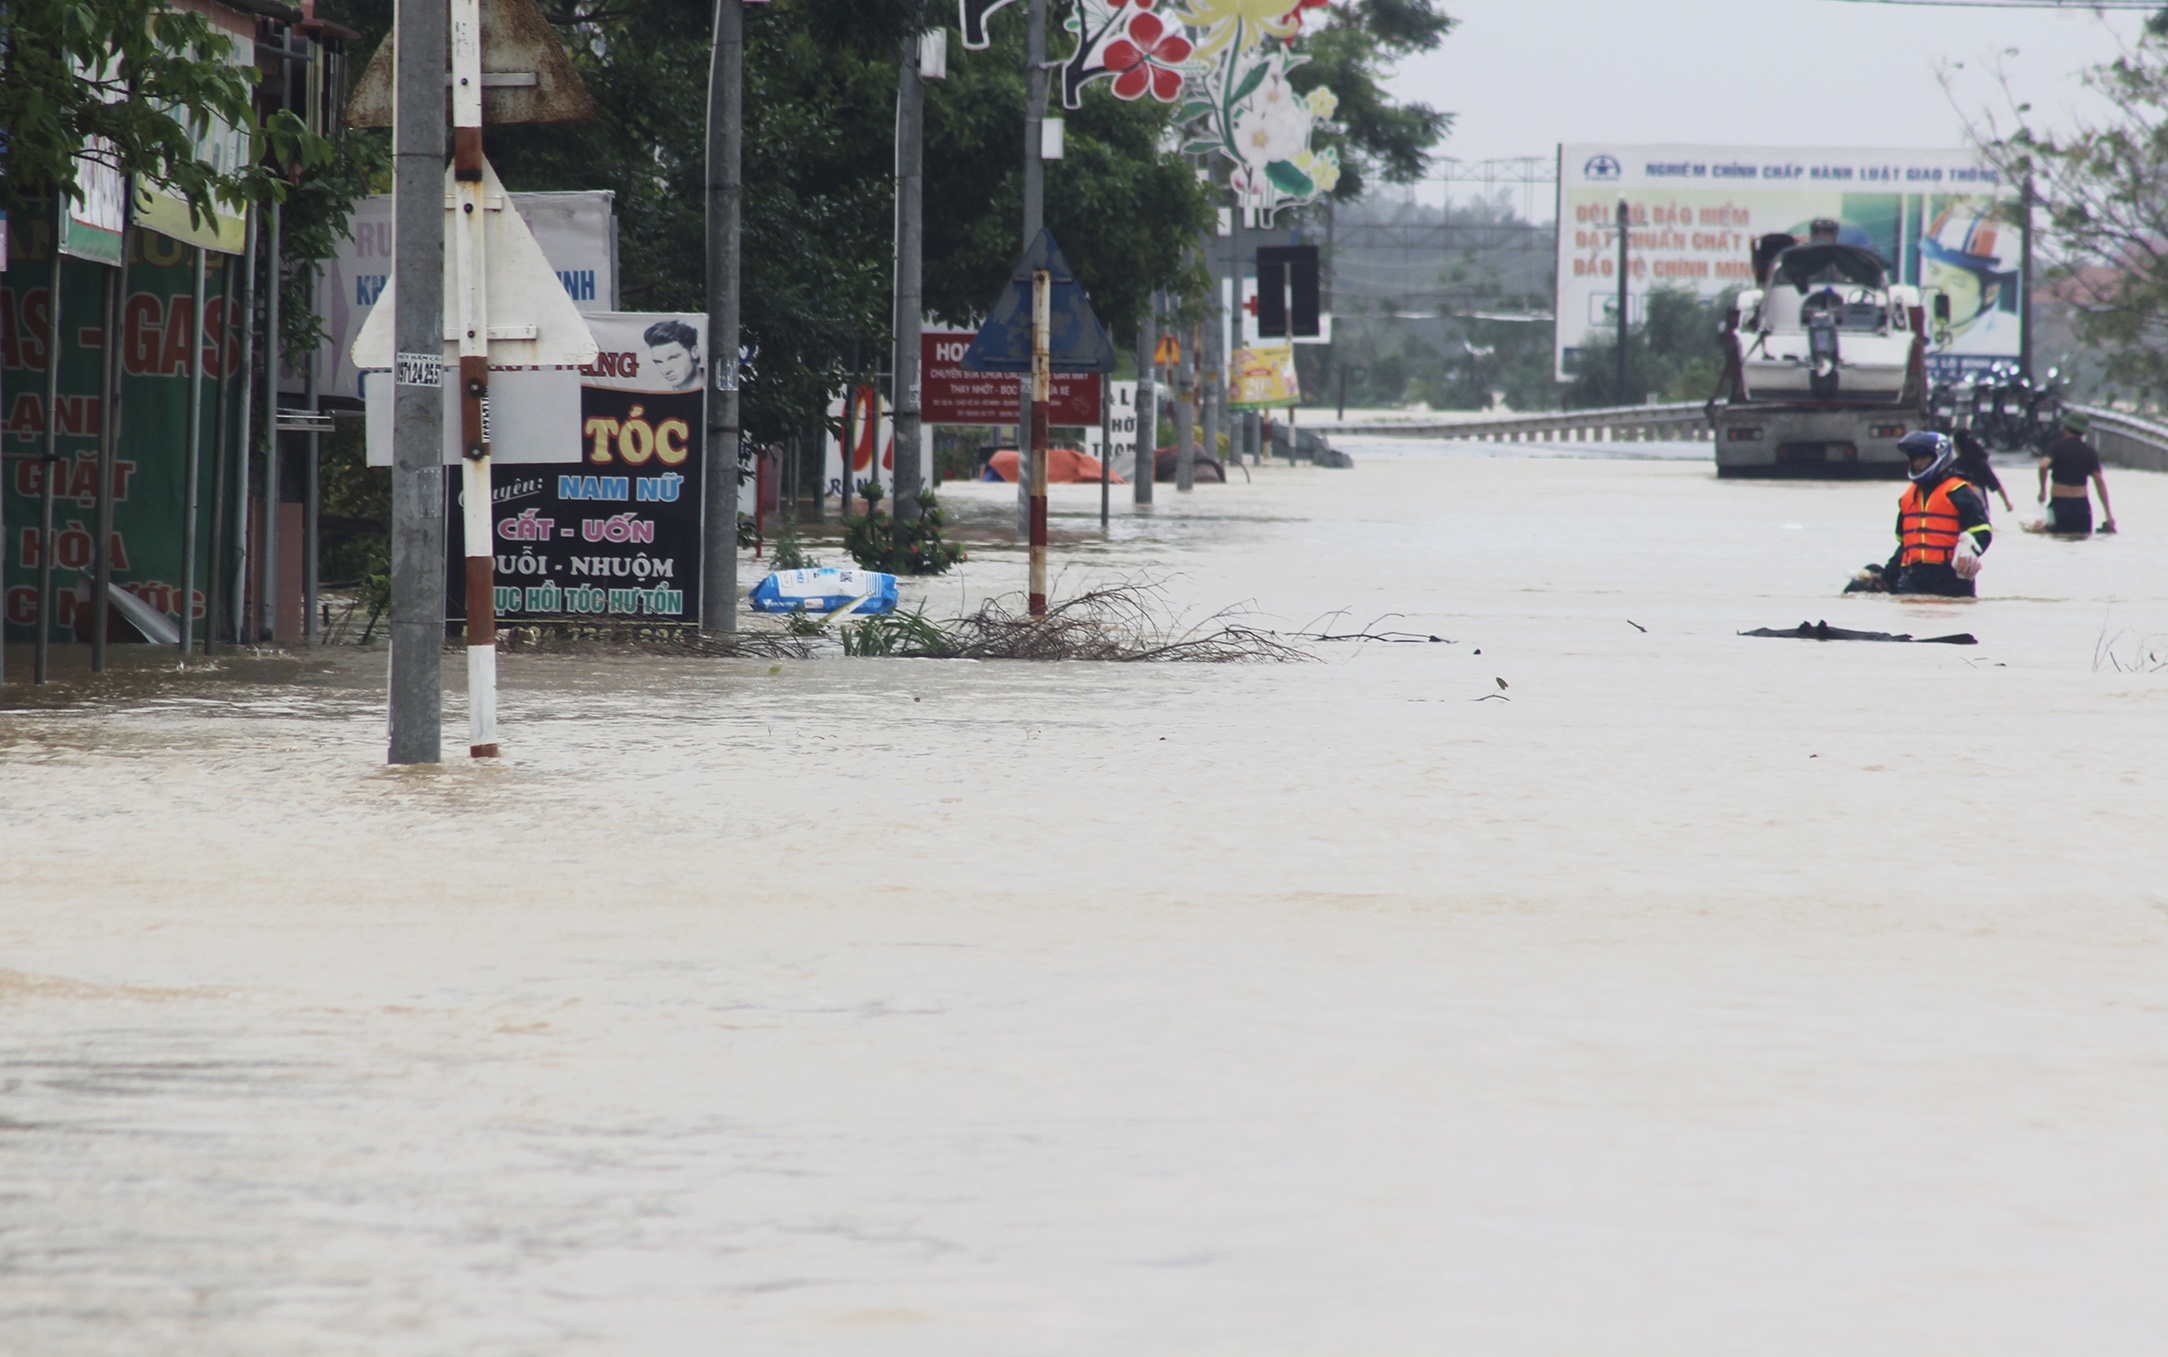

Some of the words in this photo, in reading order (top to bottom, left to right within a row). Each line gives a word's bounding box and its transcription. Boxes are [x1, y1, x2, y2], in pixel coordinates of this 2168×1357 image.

[122, 291, 243, 380] GAS
[585, 404, 689, 466] TÓC
[558, 475, 628, 501] NAM
[636, 472, 684, 501] NỮ
[498, 508, 554, 541] CẮT
[582, 512, 654, 543] UỐN
[570, 552, 674, 582] NHUỘM
[494, 587, 522, 616] ỤC
[525, 580, 561, 612] HỒI
[565, 583, 605, 612] TÓC
[642, 581, 683, 615] TỔN
